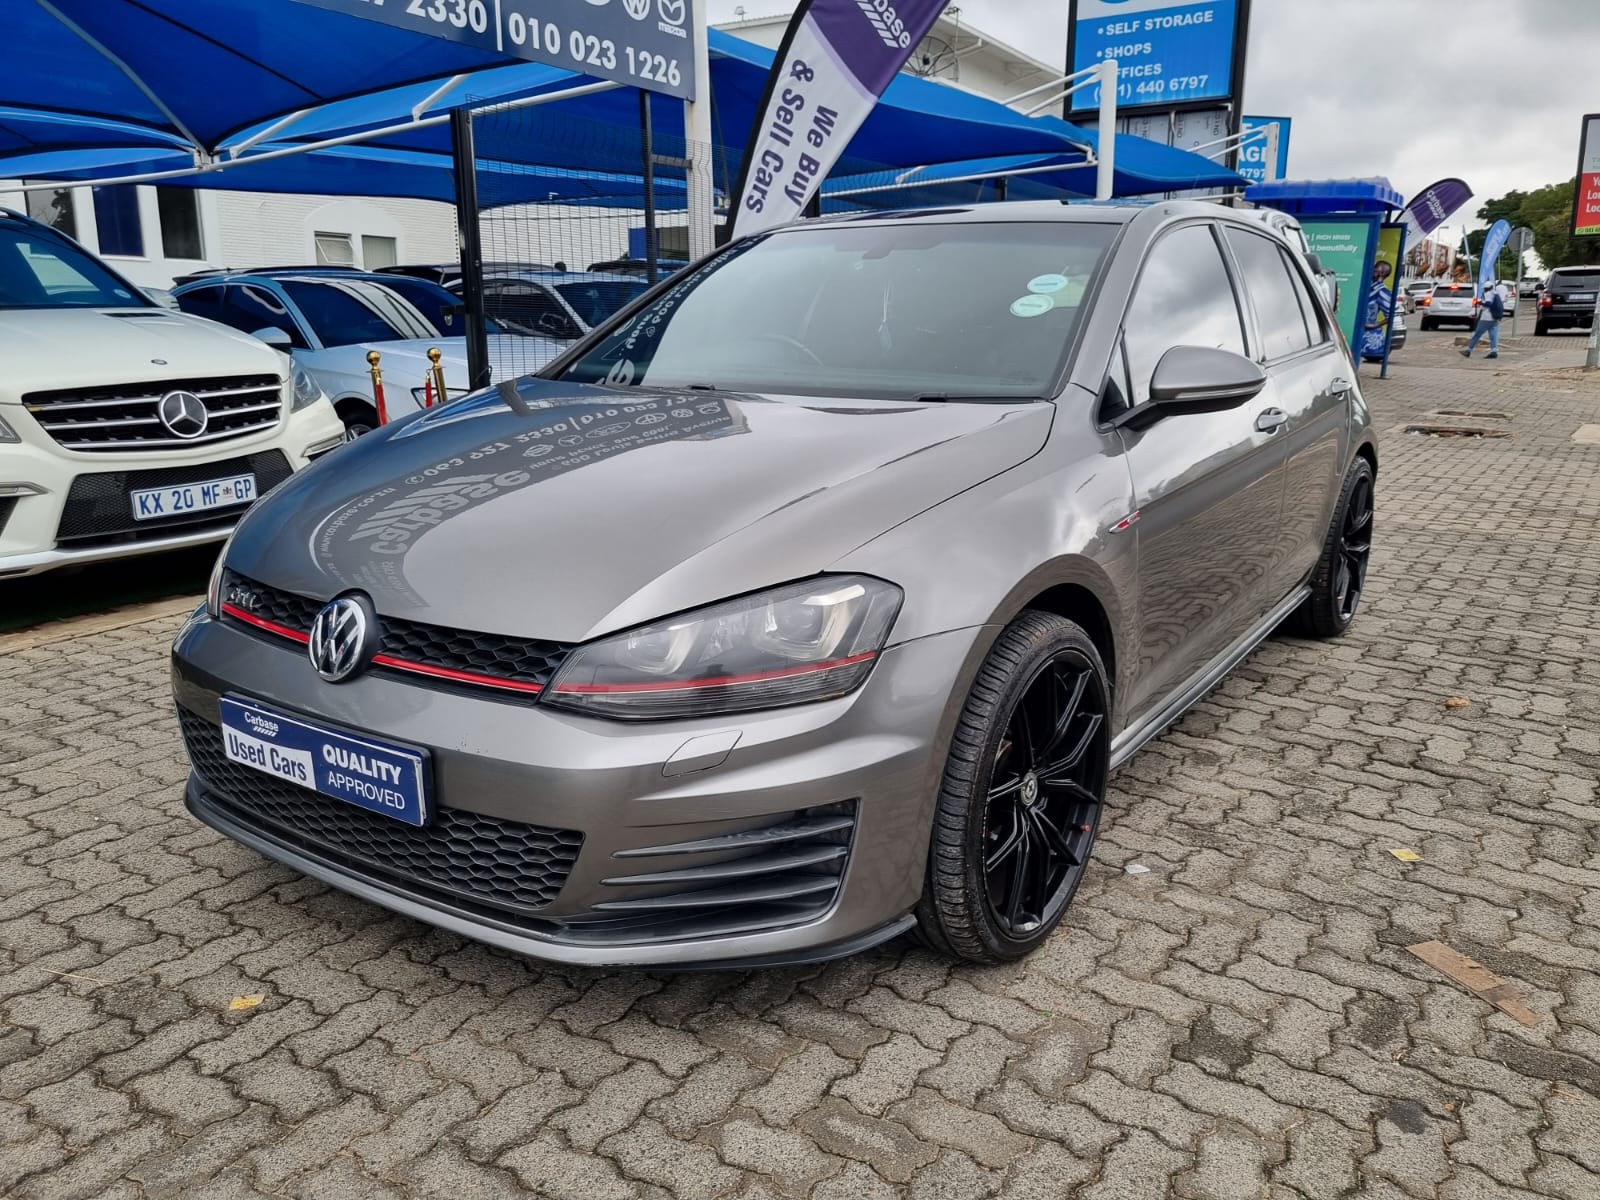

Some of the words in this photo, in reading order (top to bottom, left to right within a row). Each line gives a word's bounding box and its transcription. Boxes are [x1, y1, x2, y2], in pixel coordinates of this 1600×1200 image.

[1105, 20, 1141, 36] SELF
[1144, 10, 1214, 31] STORAGE
[508, 12, 561, 54] 010
[569, 31, 617, 70] 023
[625, 46, 681, 87] 1226
[1104, 42, 1152, 58] SHOPS
[791, 59, 814, 82] &
[1136, 80, 1165, 93] 440
[1169, 75, 1208, 91] 6797
[769, 88, 805, 147] Sell
[807, 104, 839, 148] We
[746, 149, 784, 214] Cars
[784, 151, 820, 206] Buy
[138, 492, 164, 515] KX
[171, 488, 194, 510] 20
[201, 484, 220, 506] MF
[234, 479, 252, 499] GP
[244, 711, 279, 732] Carbase
[228, 732, 266, 767] Used
[270, 747, 307, 782] Cars
[322, 744, 402, 785] QUALITY
[328, 771, 406, 810] APPROVED
